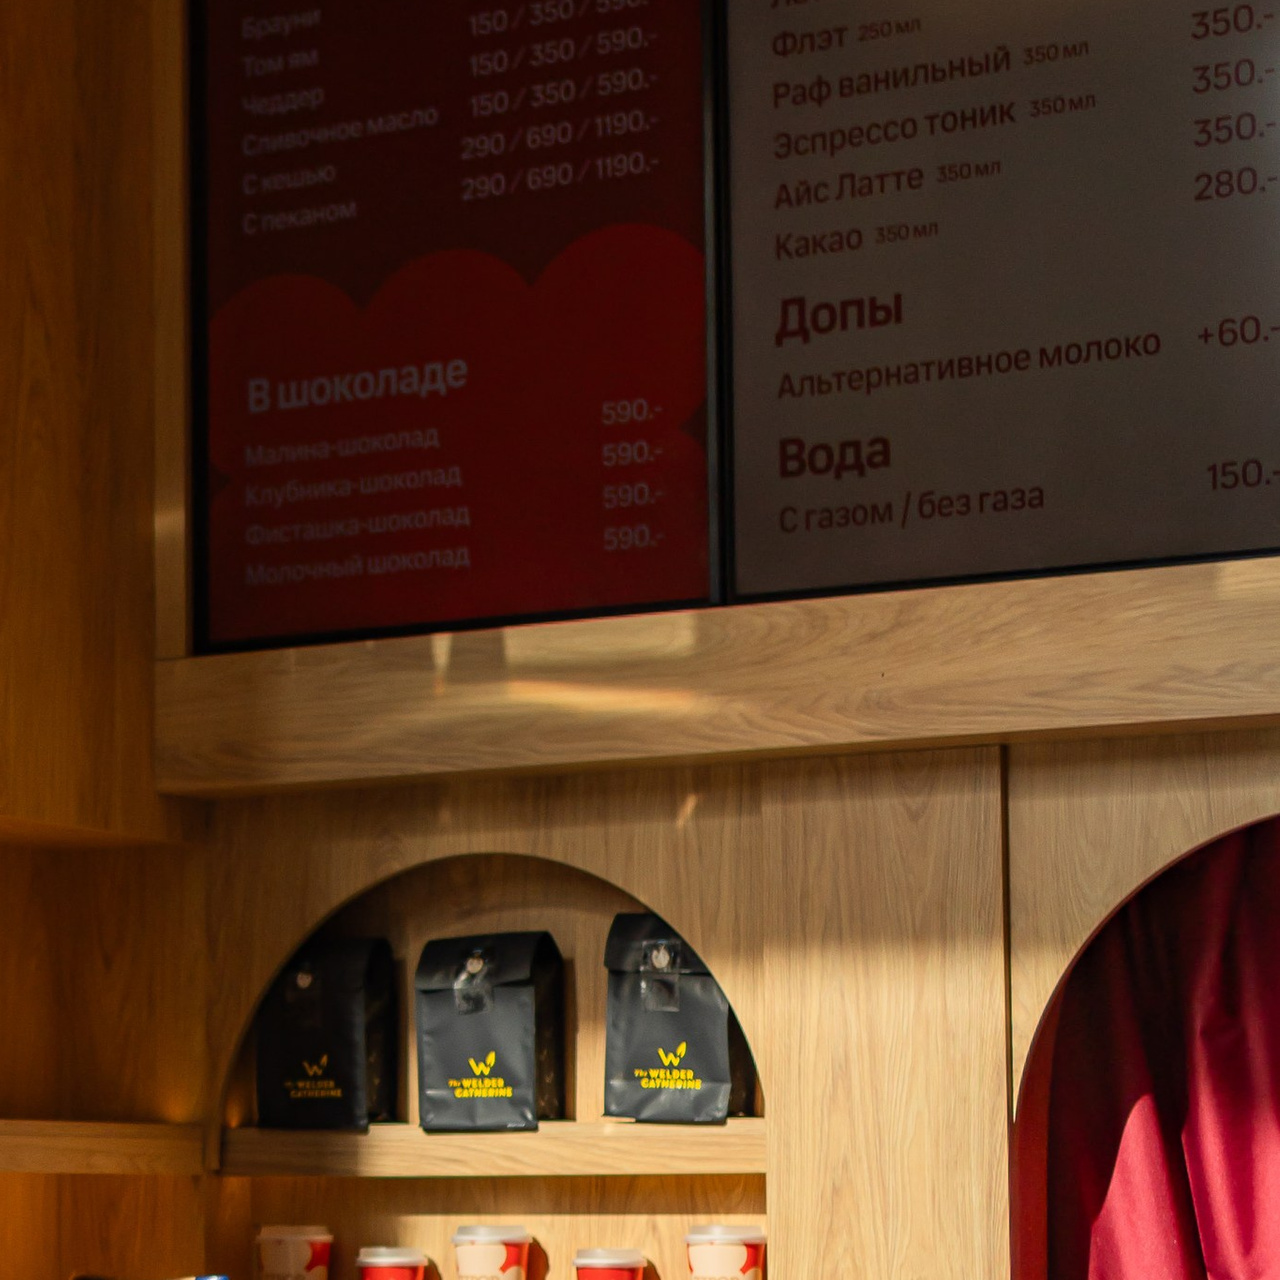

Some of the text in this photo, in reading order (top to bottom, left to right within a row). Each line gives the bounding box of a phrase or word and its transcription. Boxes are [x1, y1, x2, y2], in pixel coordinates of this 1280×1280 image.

[242, 10, 321, 40] Брауни
[469, 10, 508, 35] 150
[1192, 5, 1273, 40] 350.-
[470, 50, 508, 76] 150
[530, 38, 575, 66] 350
[772, 27, 848, 57] Флэт
[243, 56, 284, 76] Том
[773, 75, 831, 108] Раф
[839, 45, 1010, 97] ванильный
[1193, 59, 1274, 93] 350.-
[471, 91, 509, 116] 150
[532, 79, 575, 107] 350
[242, 107, 438, 156] Сливочное масло
[461, 132, 505, 160] 290
[526, 121, 572, 149] 690
[774, 118, 917, 159] Эспрессо
[925, 102, 1015, 135] тоник
[1194, 113, 1275, 147] 350.-
[261, 165, 336, 191] кешью
[462, 173, 506, 201] 290
[527, 163, 573, 190] 690
[774, 180, 829, 209] Айс
[835, 168, 924, 200] Латте
[1195, 167, 1277, 201] 280.-
[262, 201, 357, 230] пеканом
[776, 229, 863, 260] Какао
[775, 293, 902, 347] Допы
[778, 333, 1160, 399] Альтернативное молоко
[248, 359, 468, 413] В шоколаде
[603, 398, 662, 425] 590.-
[246, 428, 440, 464] Малина-шоколад
[602, 440, 663, 466] 590.-
[779, 437, 890, 480] Вода
[245, 465, 463, 507] Клубника-шоколад
[603, 482, 662, 509] 590.-
[779, 506, 797, 533] С
[805, 502, 893, 530] газом
[918, 491, 971, 519] без
[979, 487, 1044, 513] газа
[604, 524, 663, 551] 590.-
[246, 547, 470, 585] Молочный шоколад
[462, 1078, 504, 1088] WELDER
[649, 1069, 694, 1079] WELDER
